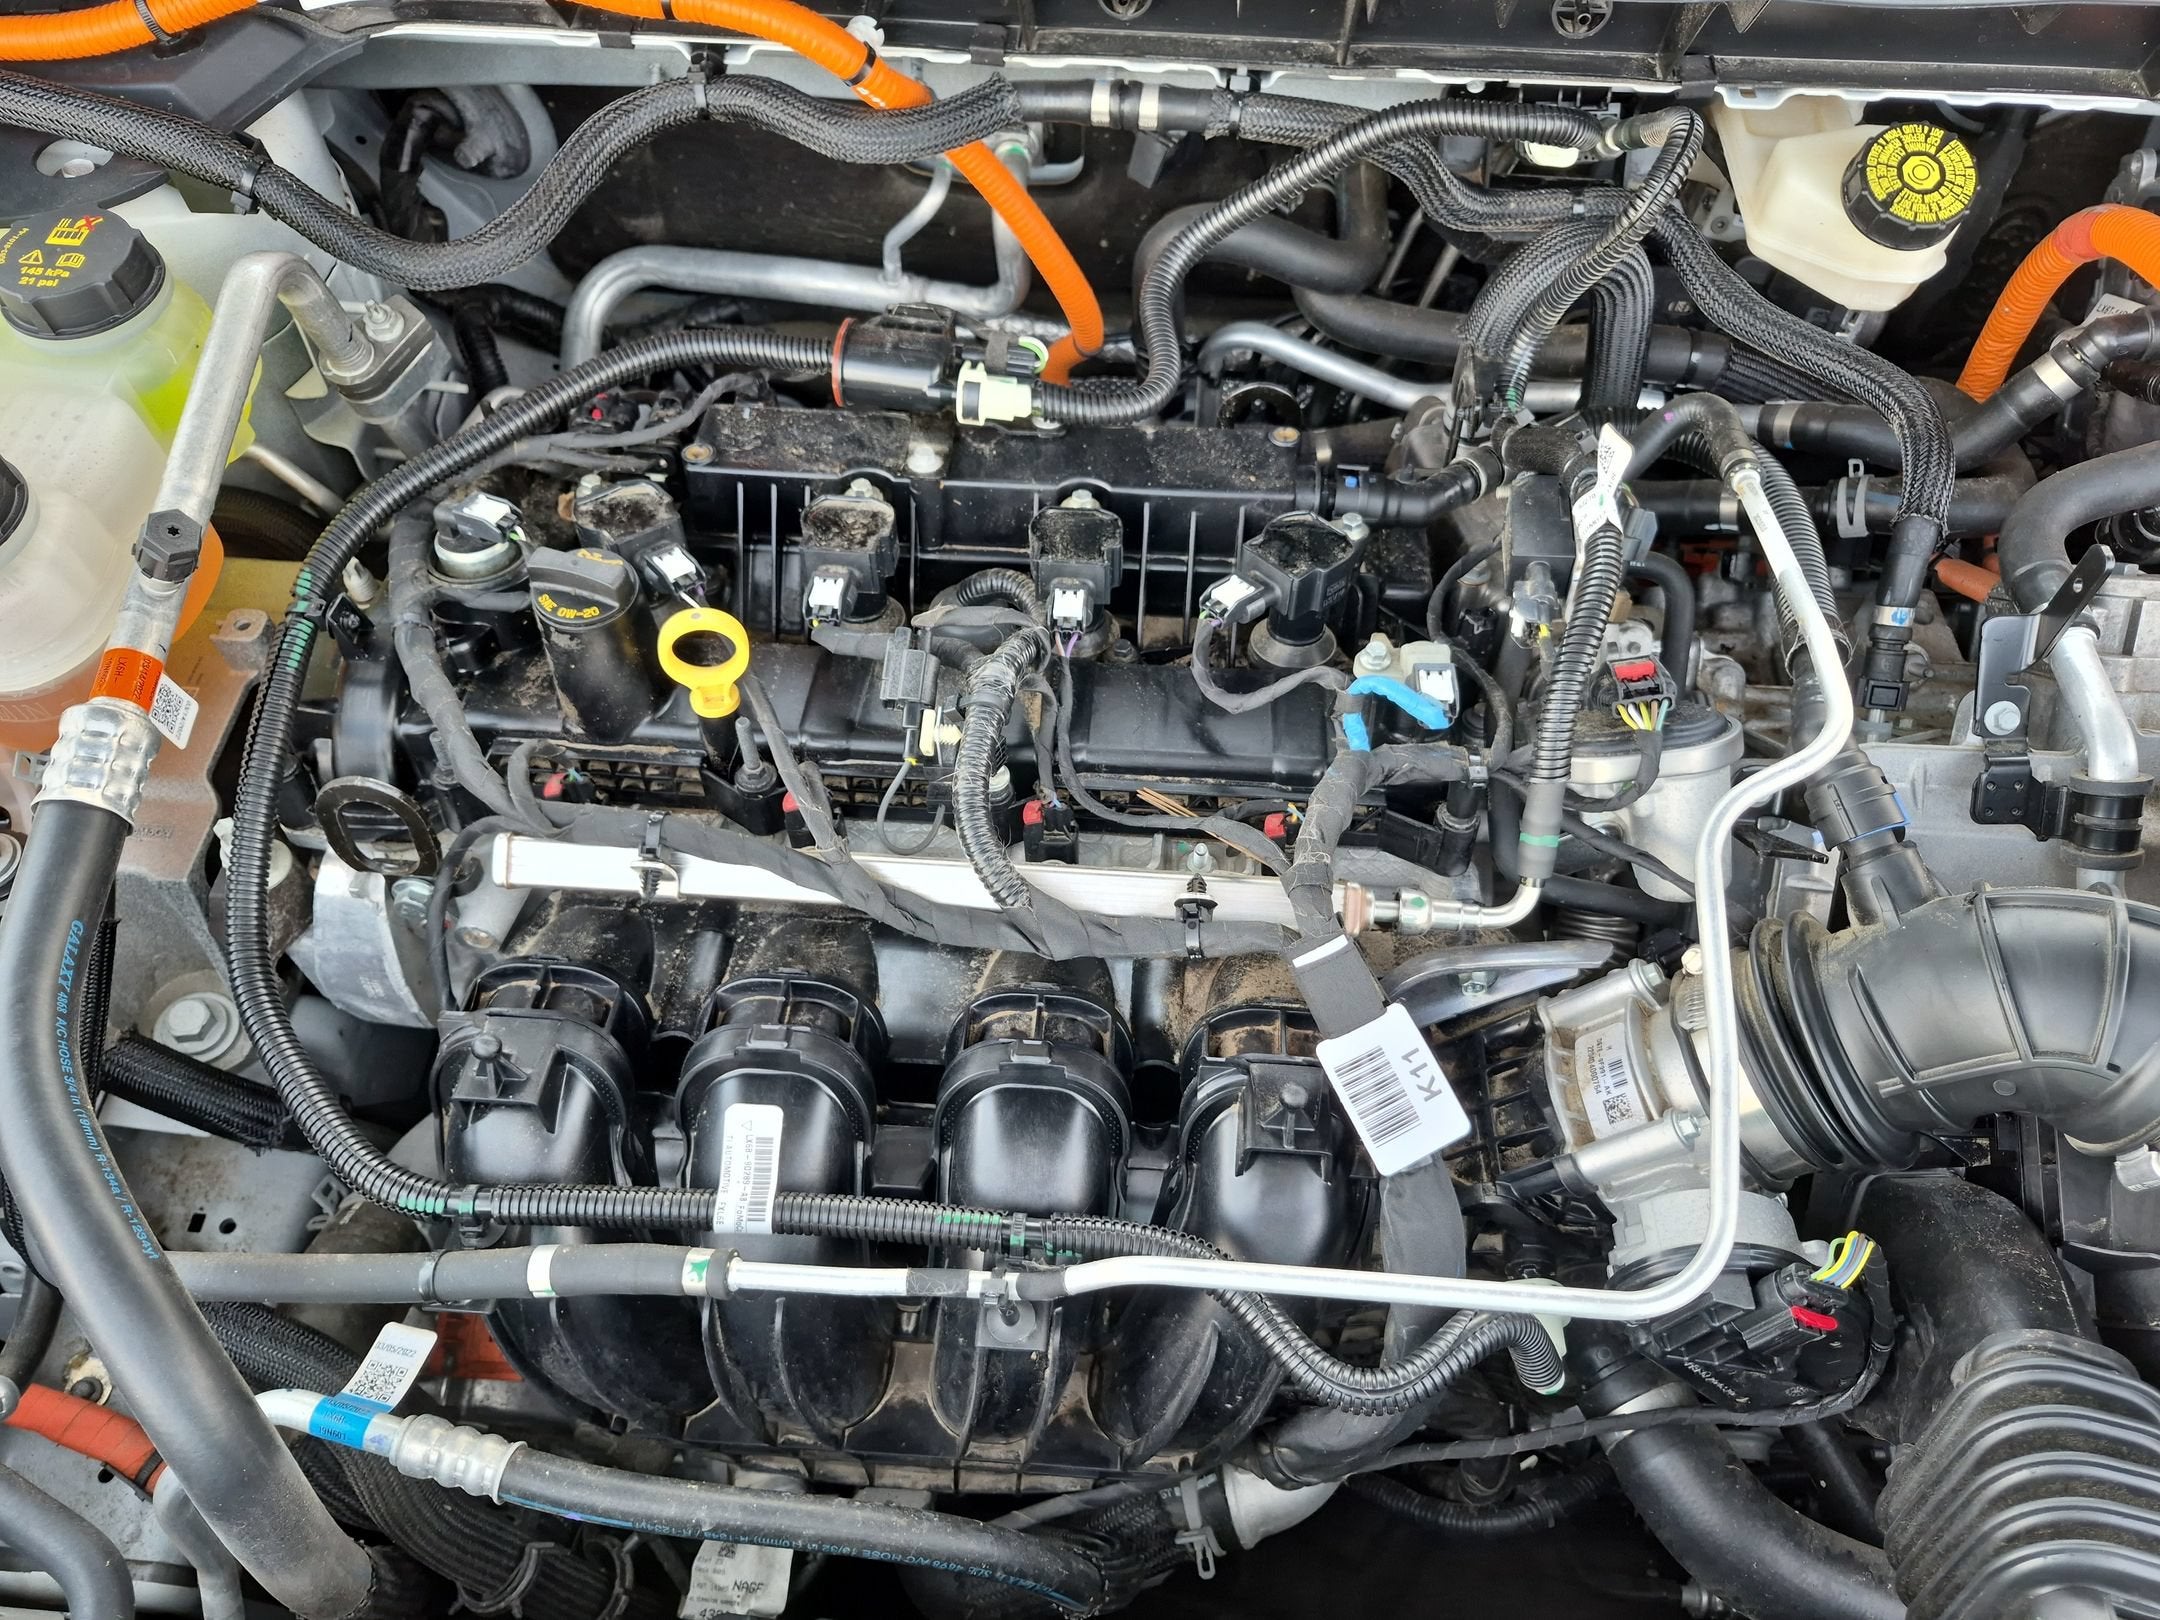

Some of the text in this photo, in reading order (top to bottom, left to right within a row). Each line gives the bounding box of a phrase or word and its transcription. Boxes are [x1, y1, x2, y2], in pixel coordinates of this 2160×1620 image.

[18, 276, 59, 288] 21 psi
[20, 266, 70, 277] 145 kPa
[538, 593, 600, 619] SAE 0W-20
[58, 919, 84, 993] GALAXY
[56, 991, 69, 1014] 4868
[56, 1016, 68, 1039] A/C
[57, 1038, 74, 1074] HOSE
[64, 1075, 78, 1094] 3/4
[1401, 1048, 1443, 1103] K11
[70, 1094, 81, 1106] in
[73, 1108, 102, 1151] (19mm)
[95, 1152, 121, 1194] R-134a
[720, 1144, 733, 1195] AUTOMOTIVE
[121, 1203, 161, 1260] R-1234yf
[863, 1548, 902, 1562] HOSE
[904, 1555, 930, 1566] A/C
